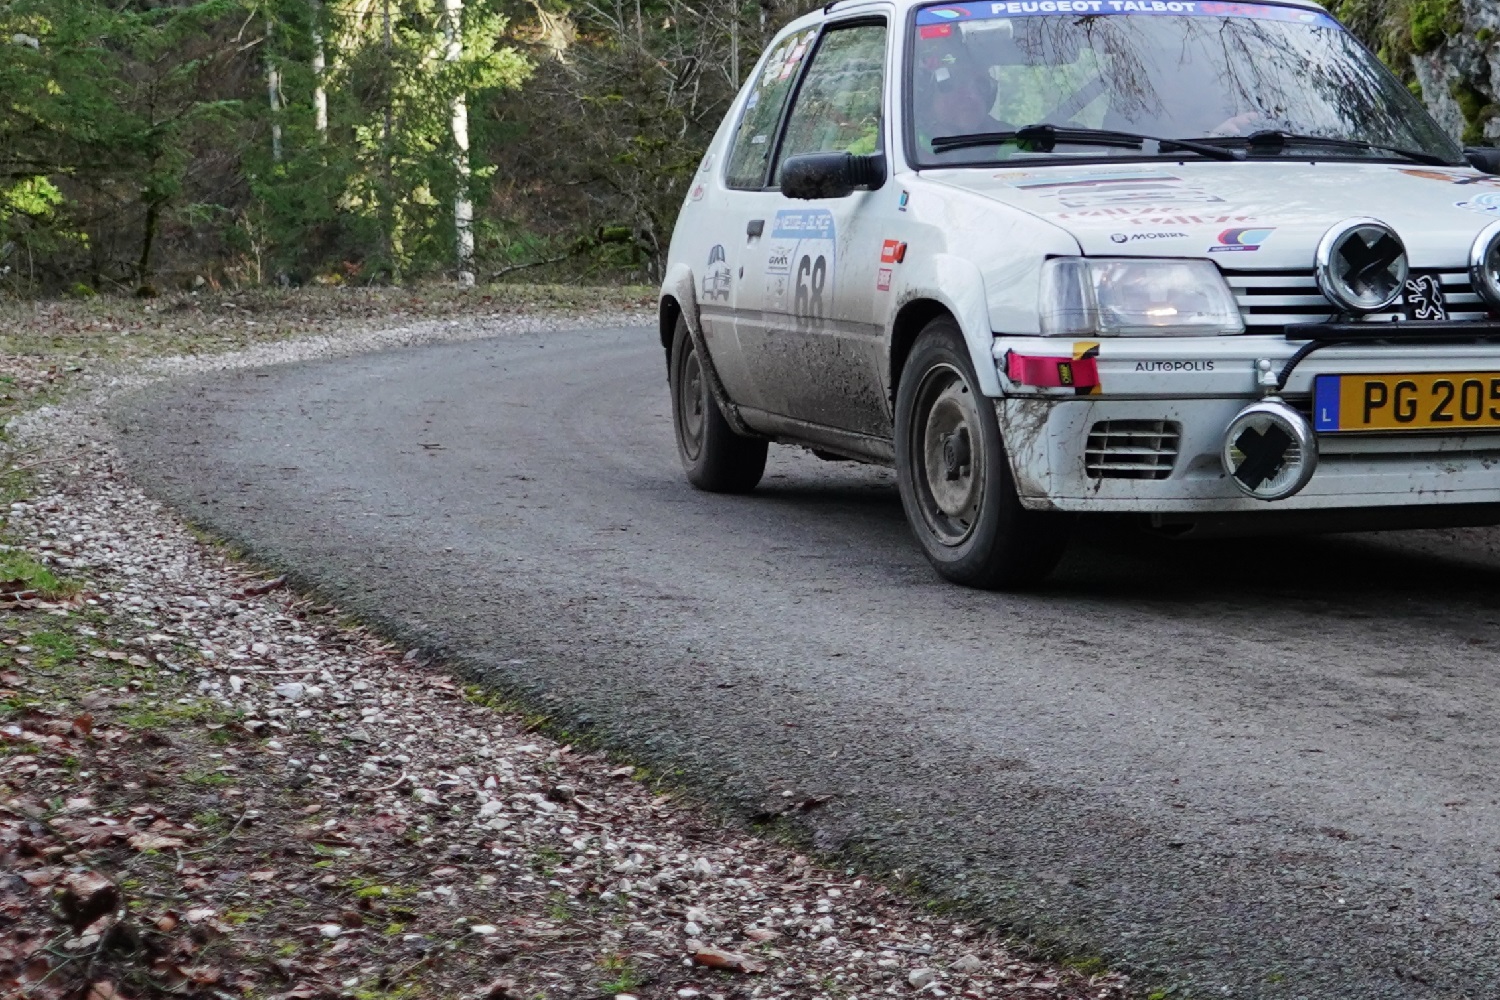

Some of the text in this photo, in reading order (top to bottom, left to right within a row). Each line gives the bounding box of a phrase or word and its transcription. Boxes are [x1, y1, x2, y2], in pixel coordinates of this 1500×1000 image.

[991, 0, 1103, 14] PEUGEOT
[1108, 1, 1196, 13] TALBOT
[794, 254, 827, 330] 68
[1135, 360, 1215, 372] AUTOPOLIS
[1363, 380, 1418, 424] PG
[1322, 408, 1332, 423] L
